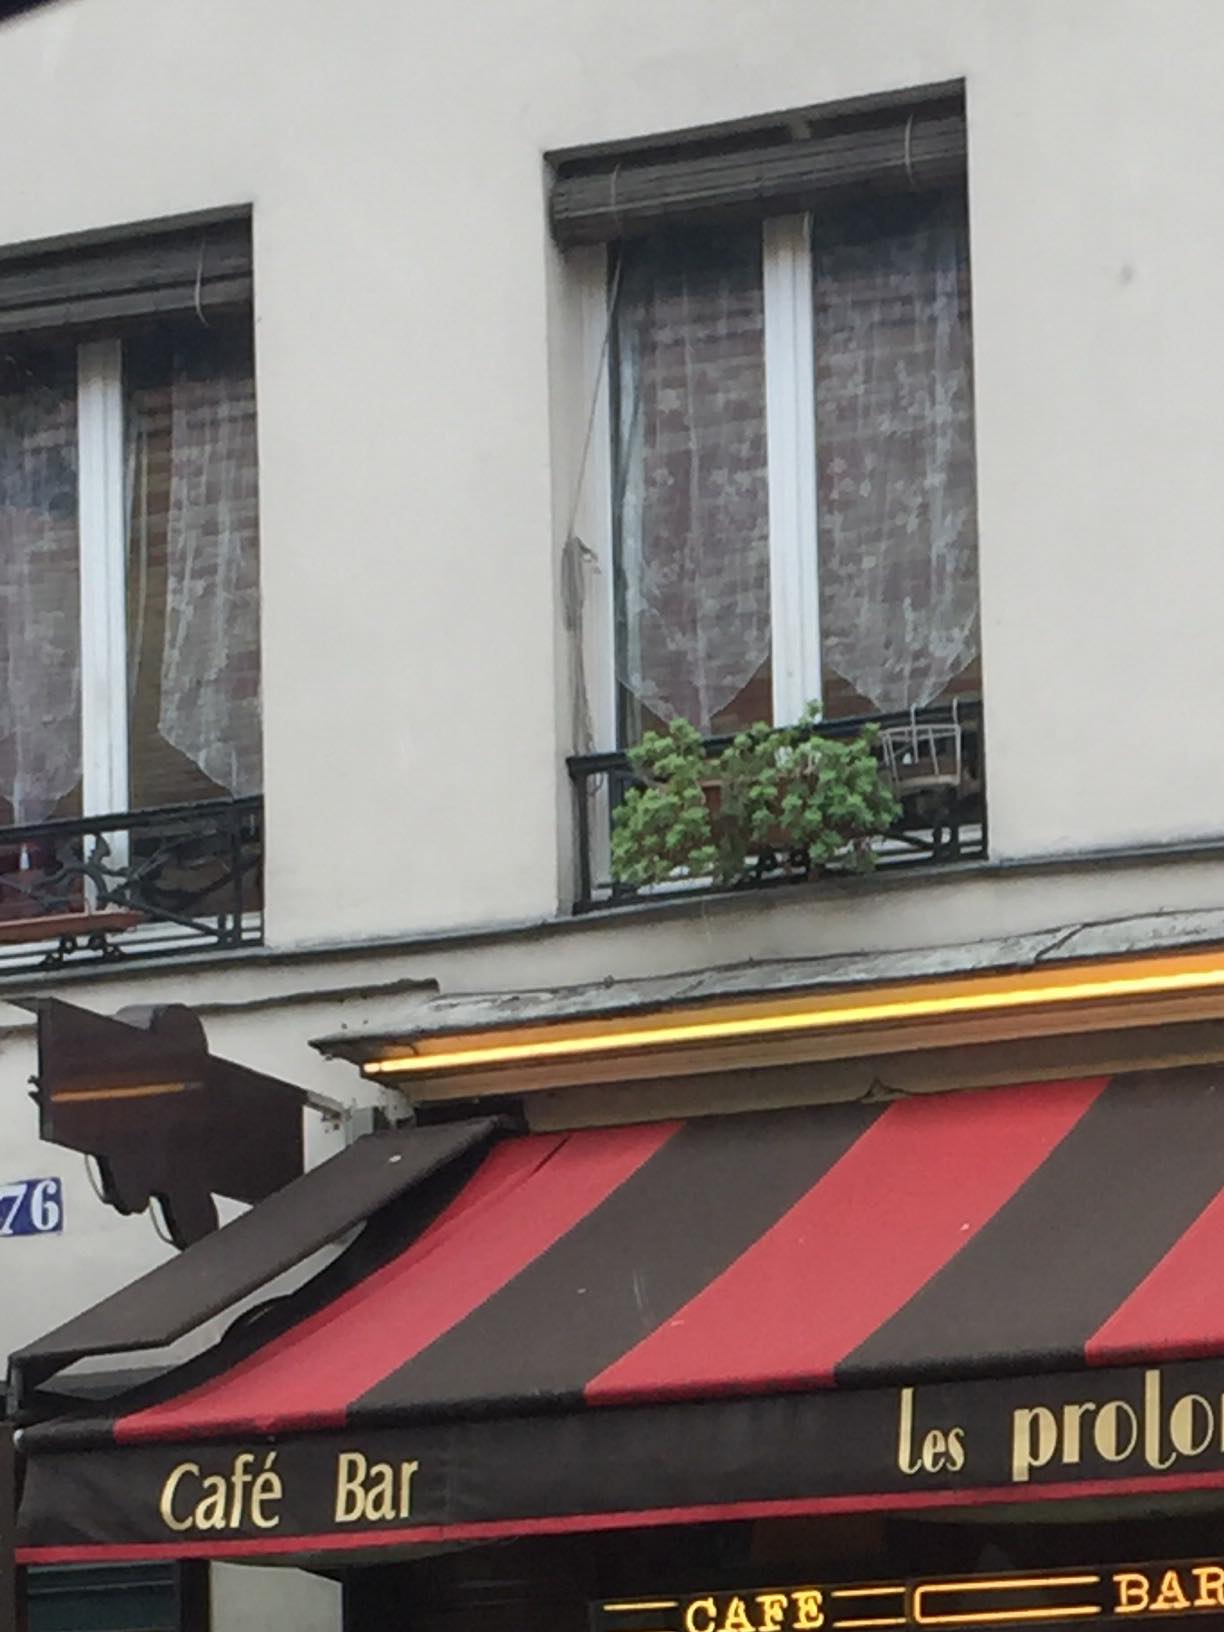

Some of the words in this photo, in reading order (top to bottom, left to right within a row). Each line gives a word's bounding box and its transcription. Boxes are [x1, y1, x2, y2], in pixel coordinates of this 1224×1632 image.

[0, 1180, 60, 1235] 76
[898, 1386, 966, 1475] les
[158, 1450, 283, 1532] Café
[334, 1451, 419, 1523] Bar
